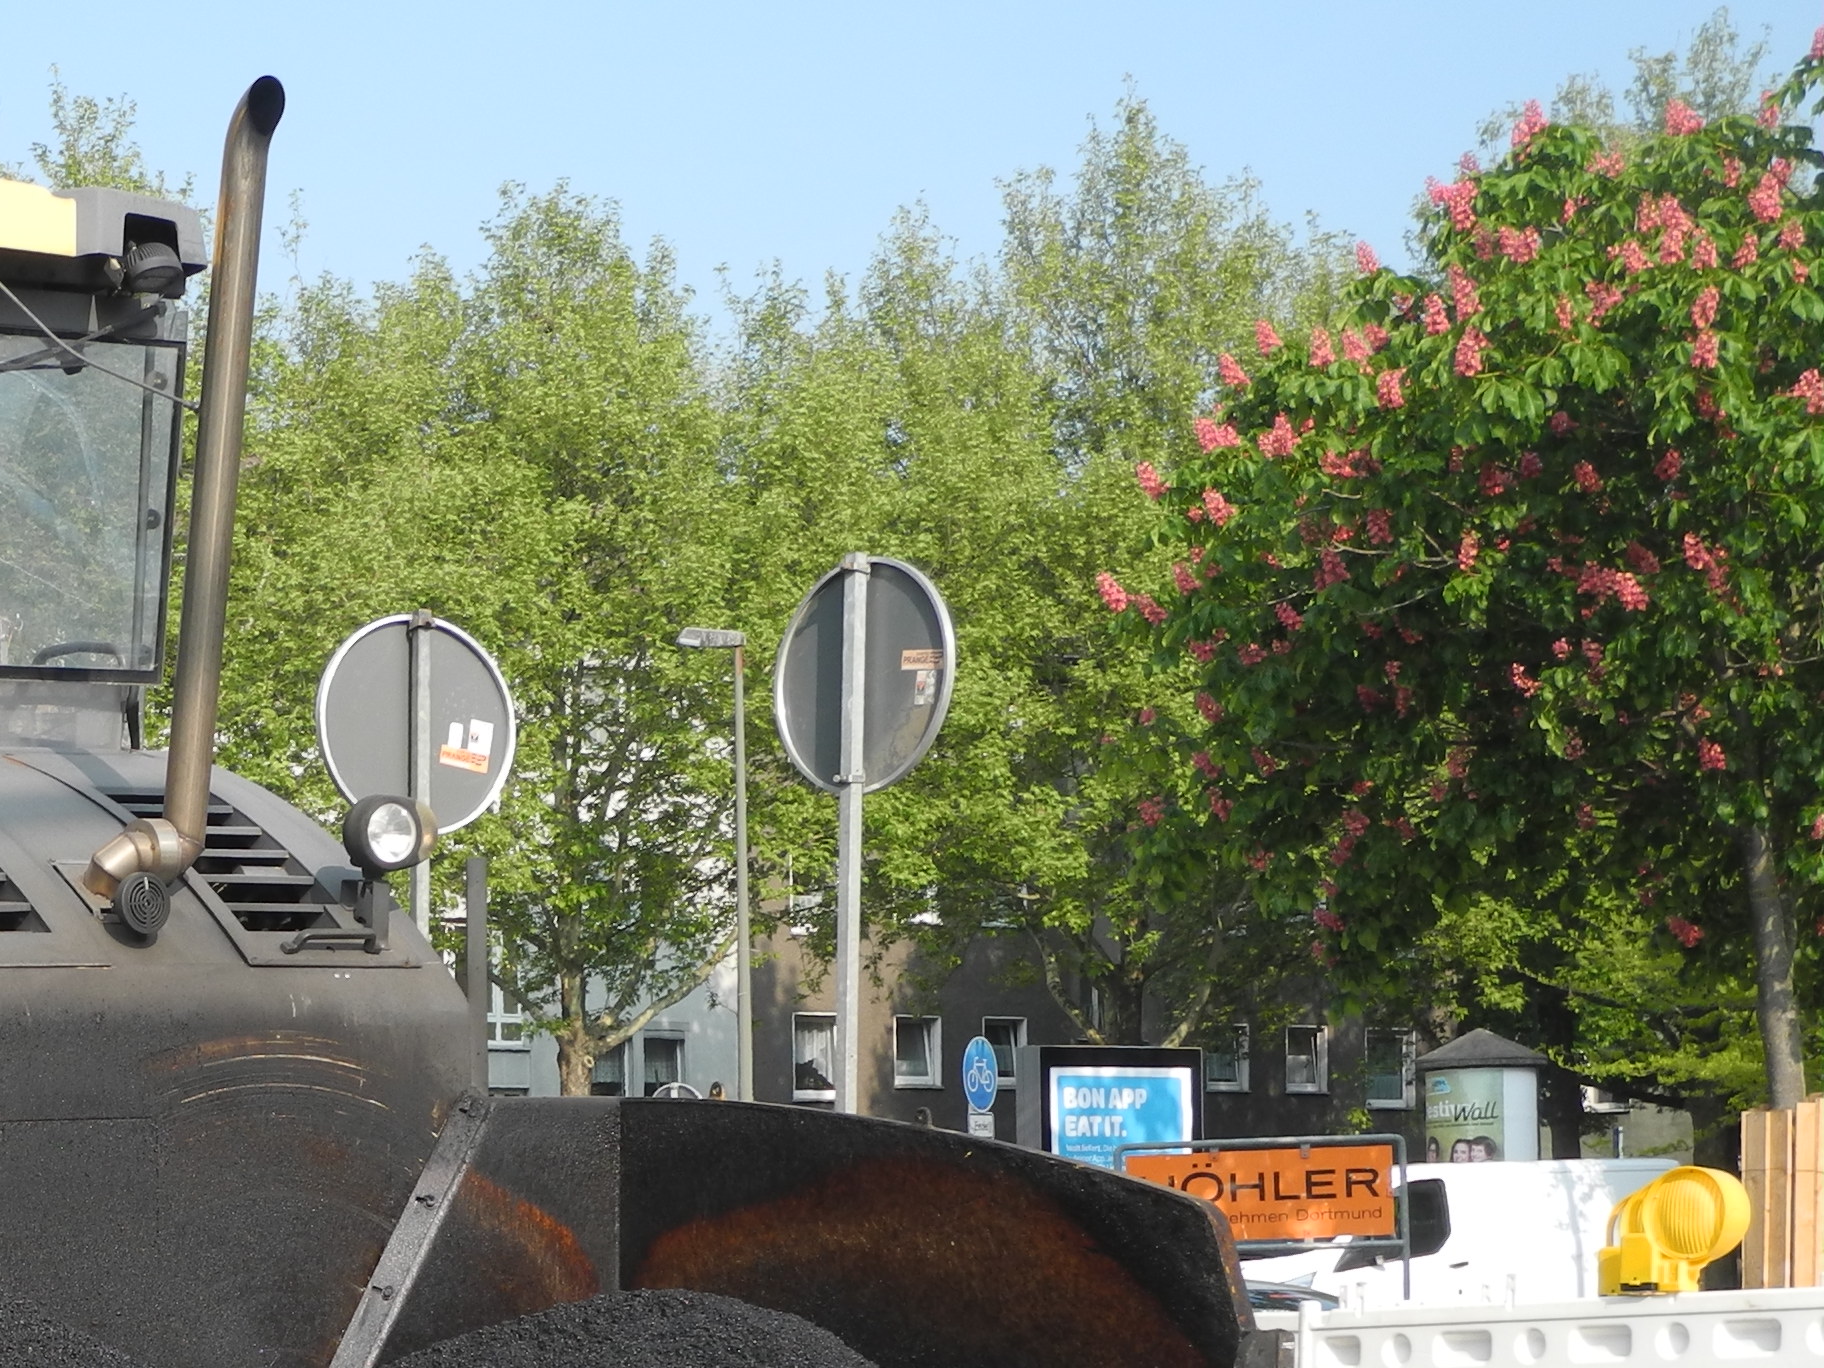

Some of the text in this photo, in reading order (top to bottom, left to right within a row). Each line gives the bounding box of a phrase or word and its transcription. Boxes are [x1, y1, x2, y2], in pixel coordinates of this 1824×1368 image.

[1063, 1086, 1148, 1110] BON APP
[1454, 1101, 1499, 1122] Wall
[1064, 1114, 1127, 1138] EAT IT.
[1296, 1206, 1383, 1223] Dortmund
